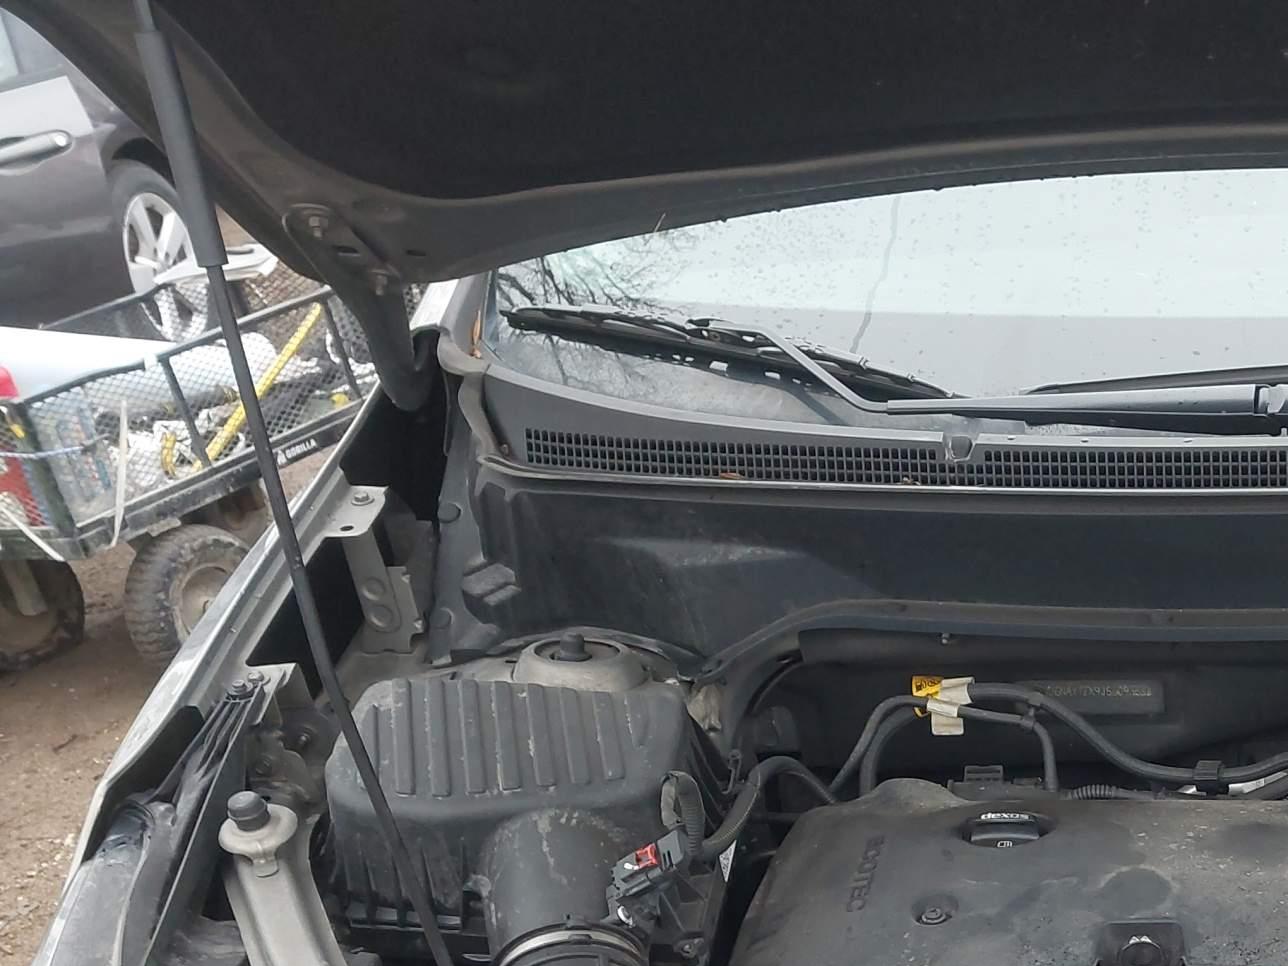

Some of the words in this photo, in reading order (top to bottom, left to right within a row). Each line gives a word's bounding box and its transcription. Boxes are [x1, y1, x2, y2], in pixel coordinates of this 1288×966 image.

[285, 438, 317, 459] GORILLA
[980, 812, 1030, 820] dexos
[846, 834, 885, 913] ECOTEC
